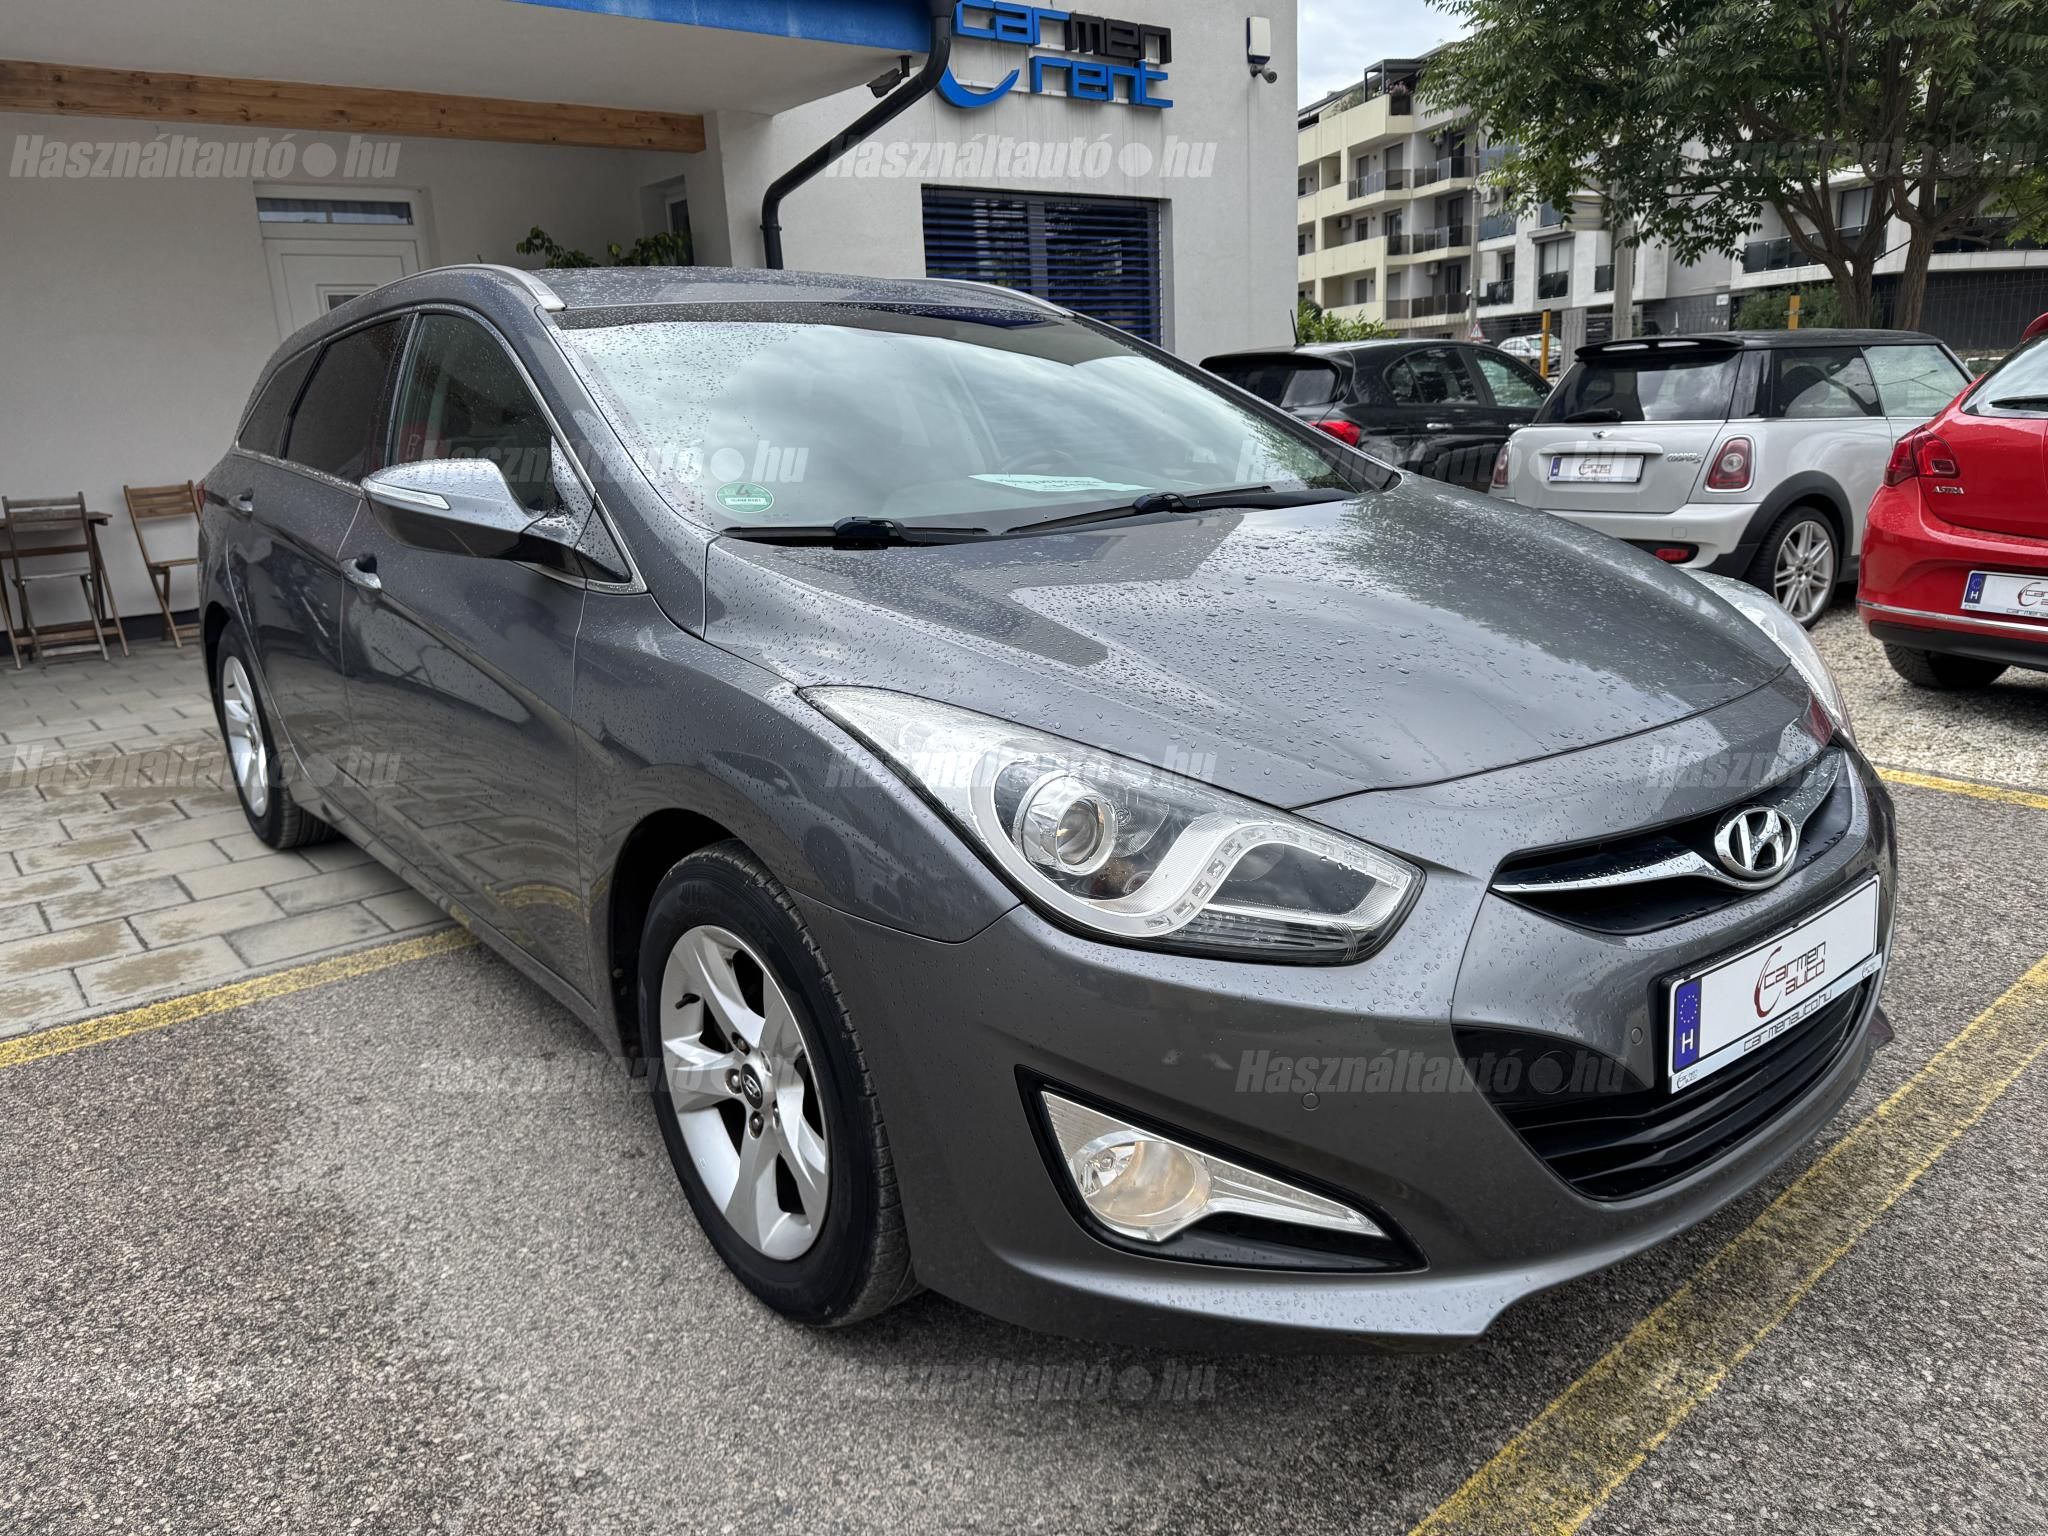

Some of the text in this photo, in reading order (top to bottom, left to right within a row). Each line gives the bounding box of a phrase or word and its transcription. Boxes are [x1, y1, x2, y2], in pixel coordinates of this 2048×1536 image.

[1029, 56, 1174, 109] rent
[1969, 590, 1979, 600] H
[1762, 940, 1827, 990] carmen
[1784, 958, 1826, 996] auto
[1681, 1028, 1695, 1054] H
